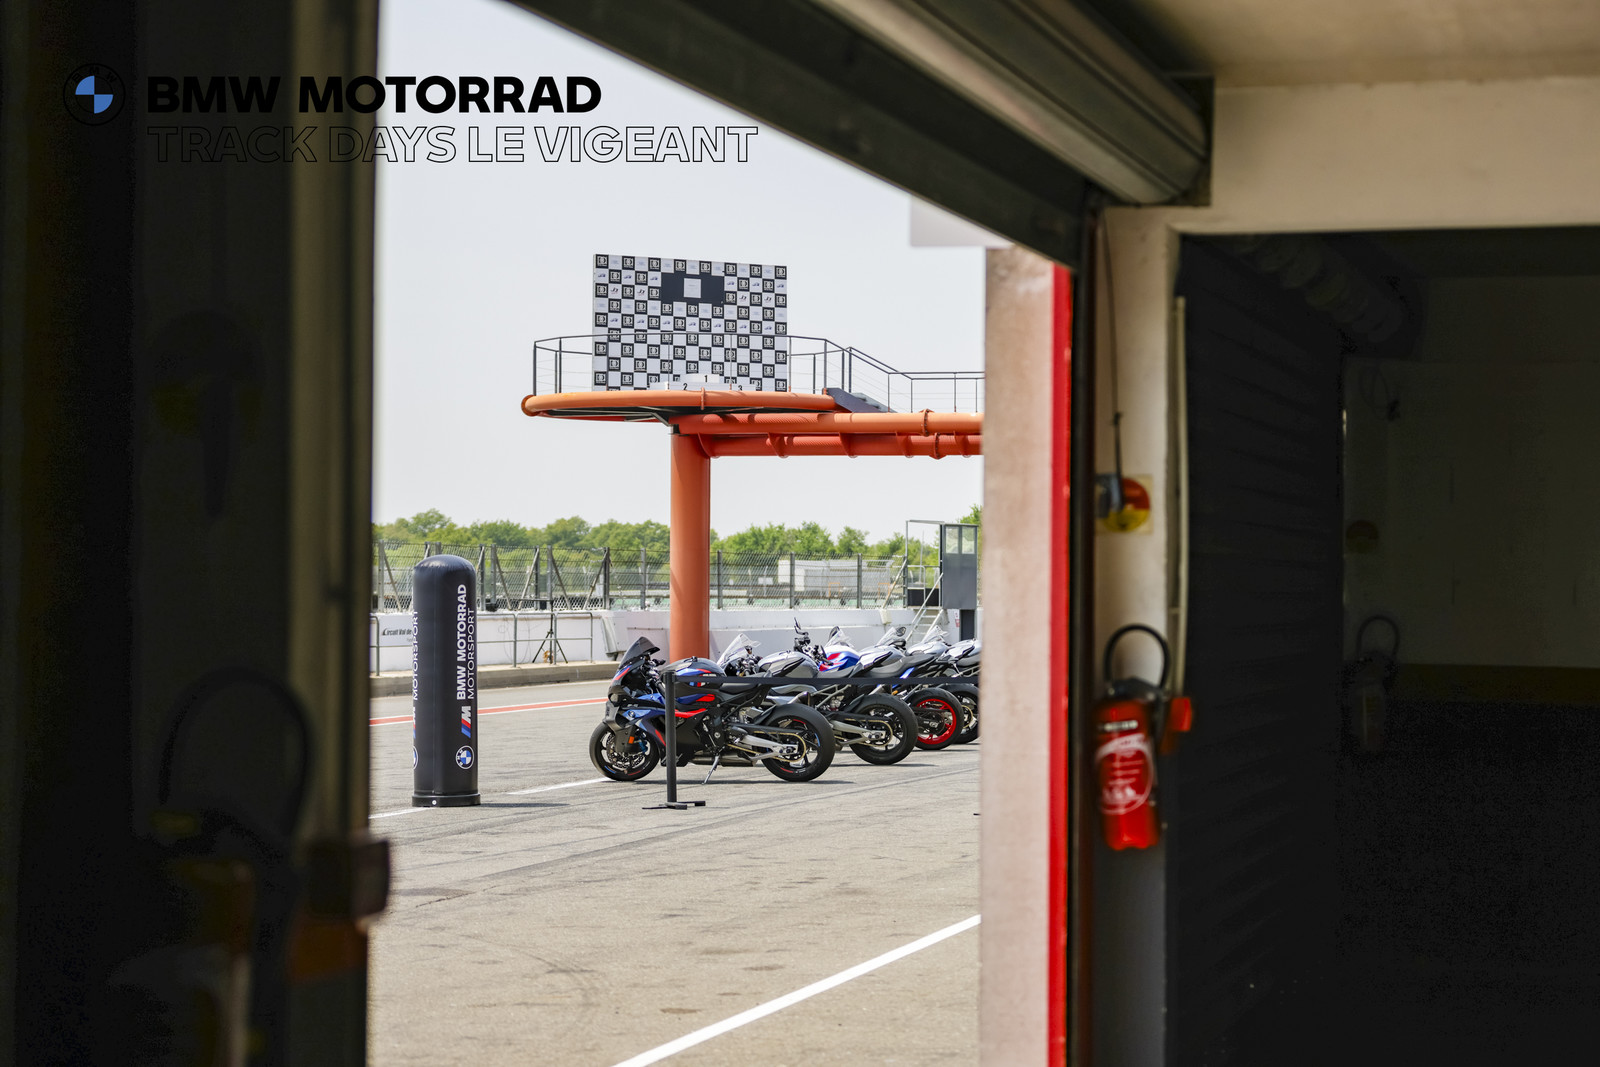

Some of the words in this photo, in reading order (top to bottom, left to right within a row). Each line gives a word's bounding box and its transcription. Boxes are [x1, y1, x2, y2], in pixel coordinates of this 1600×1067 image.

[704, 375, 708, 383] 1
[456, 584, 467, 662] MOTORRAD
[456, 663, 466, 700] BMW
[467, 607, 475, 700] MOTORSPORT
